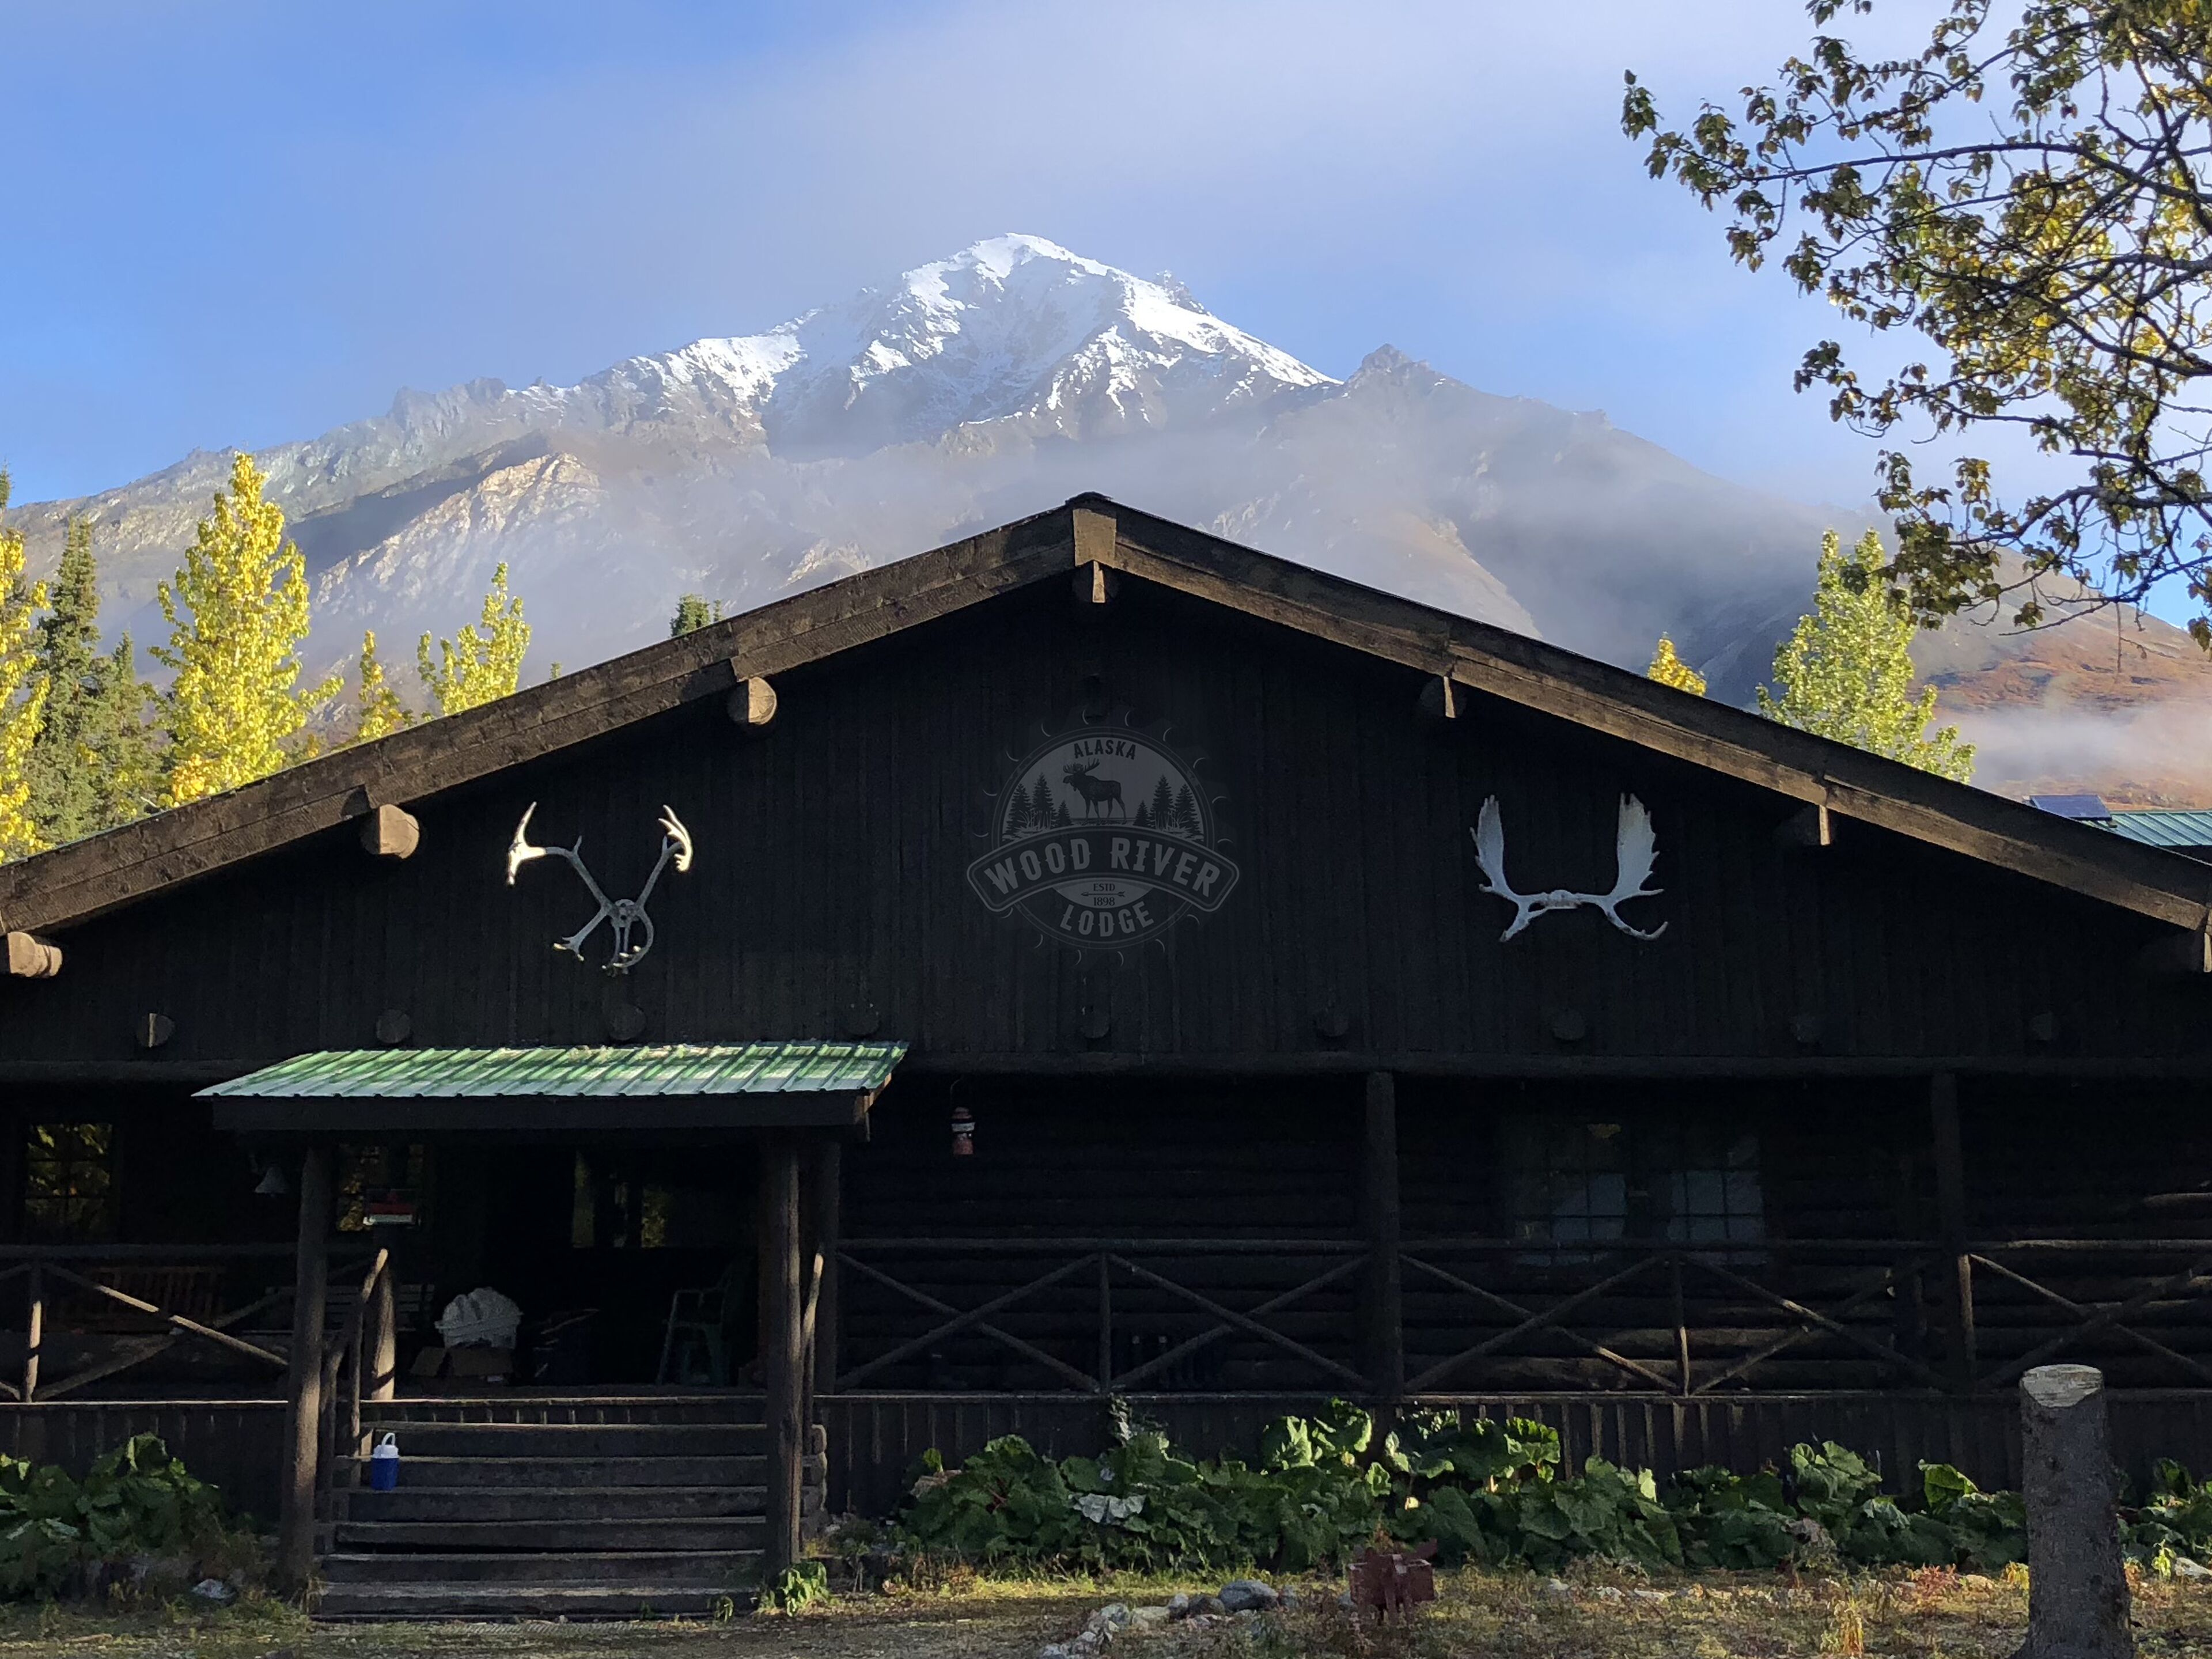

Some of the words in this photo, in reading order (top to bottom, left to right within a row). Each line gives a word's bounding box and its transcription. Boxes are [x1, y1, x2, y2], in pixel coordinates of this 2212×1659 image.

[1074, 739, 1137, 760] ALASKA
[984, 838, 1091, 895] WOOD
[1110, 837, 1220, 897] RIVER
[1093, 897, 1115, 906] 1898
[1060, 902, 1154, 937] LODGE
